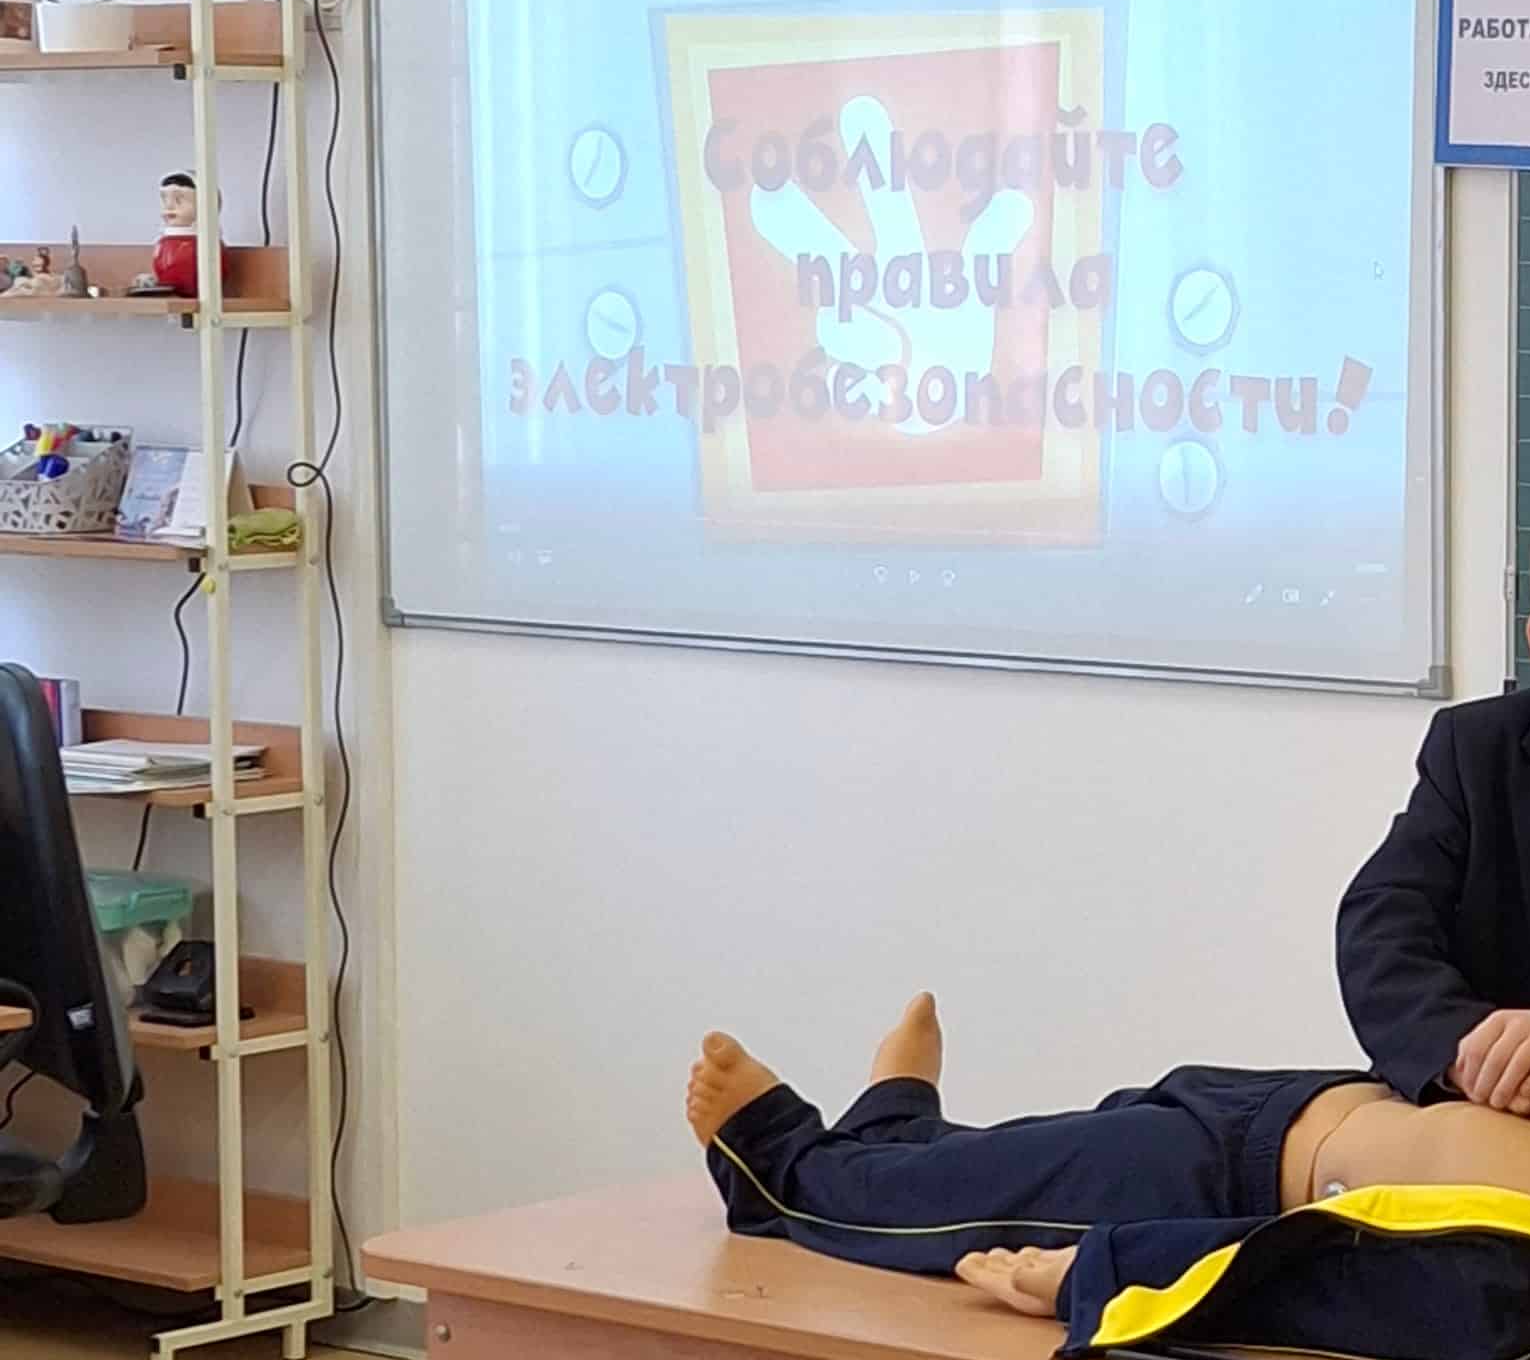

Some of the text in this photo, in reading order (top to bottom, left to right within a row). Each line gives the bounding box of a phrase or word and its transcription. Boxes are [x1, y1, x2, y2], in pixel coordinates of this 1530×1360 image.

[704, 104, 1185, 218] Соблюдайте
[795, 249, 1114, 323] правила
[508, 345, 1373, 436] электробезопасности!
